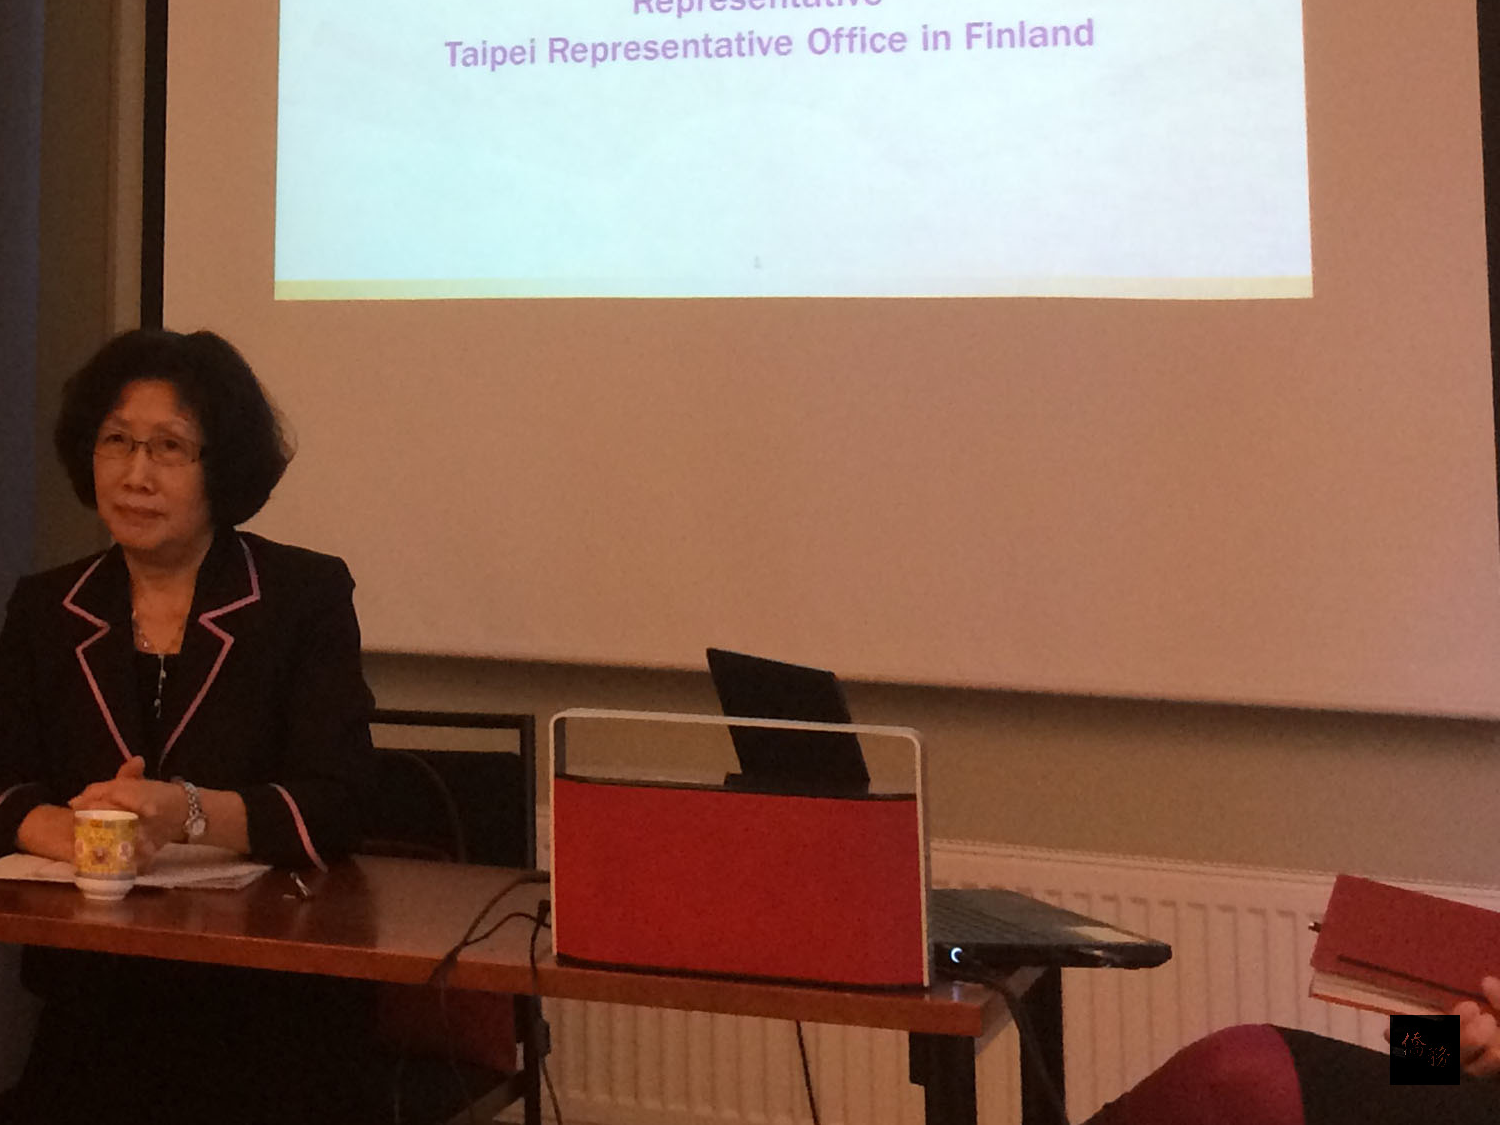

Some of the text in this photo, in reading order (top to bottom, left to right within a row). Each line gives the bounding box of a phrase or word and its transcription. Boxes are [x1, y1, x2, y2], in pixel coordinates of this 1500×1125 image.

[444, 18, 1095, 73] Taipei Representative Office in Finland
